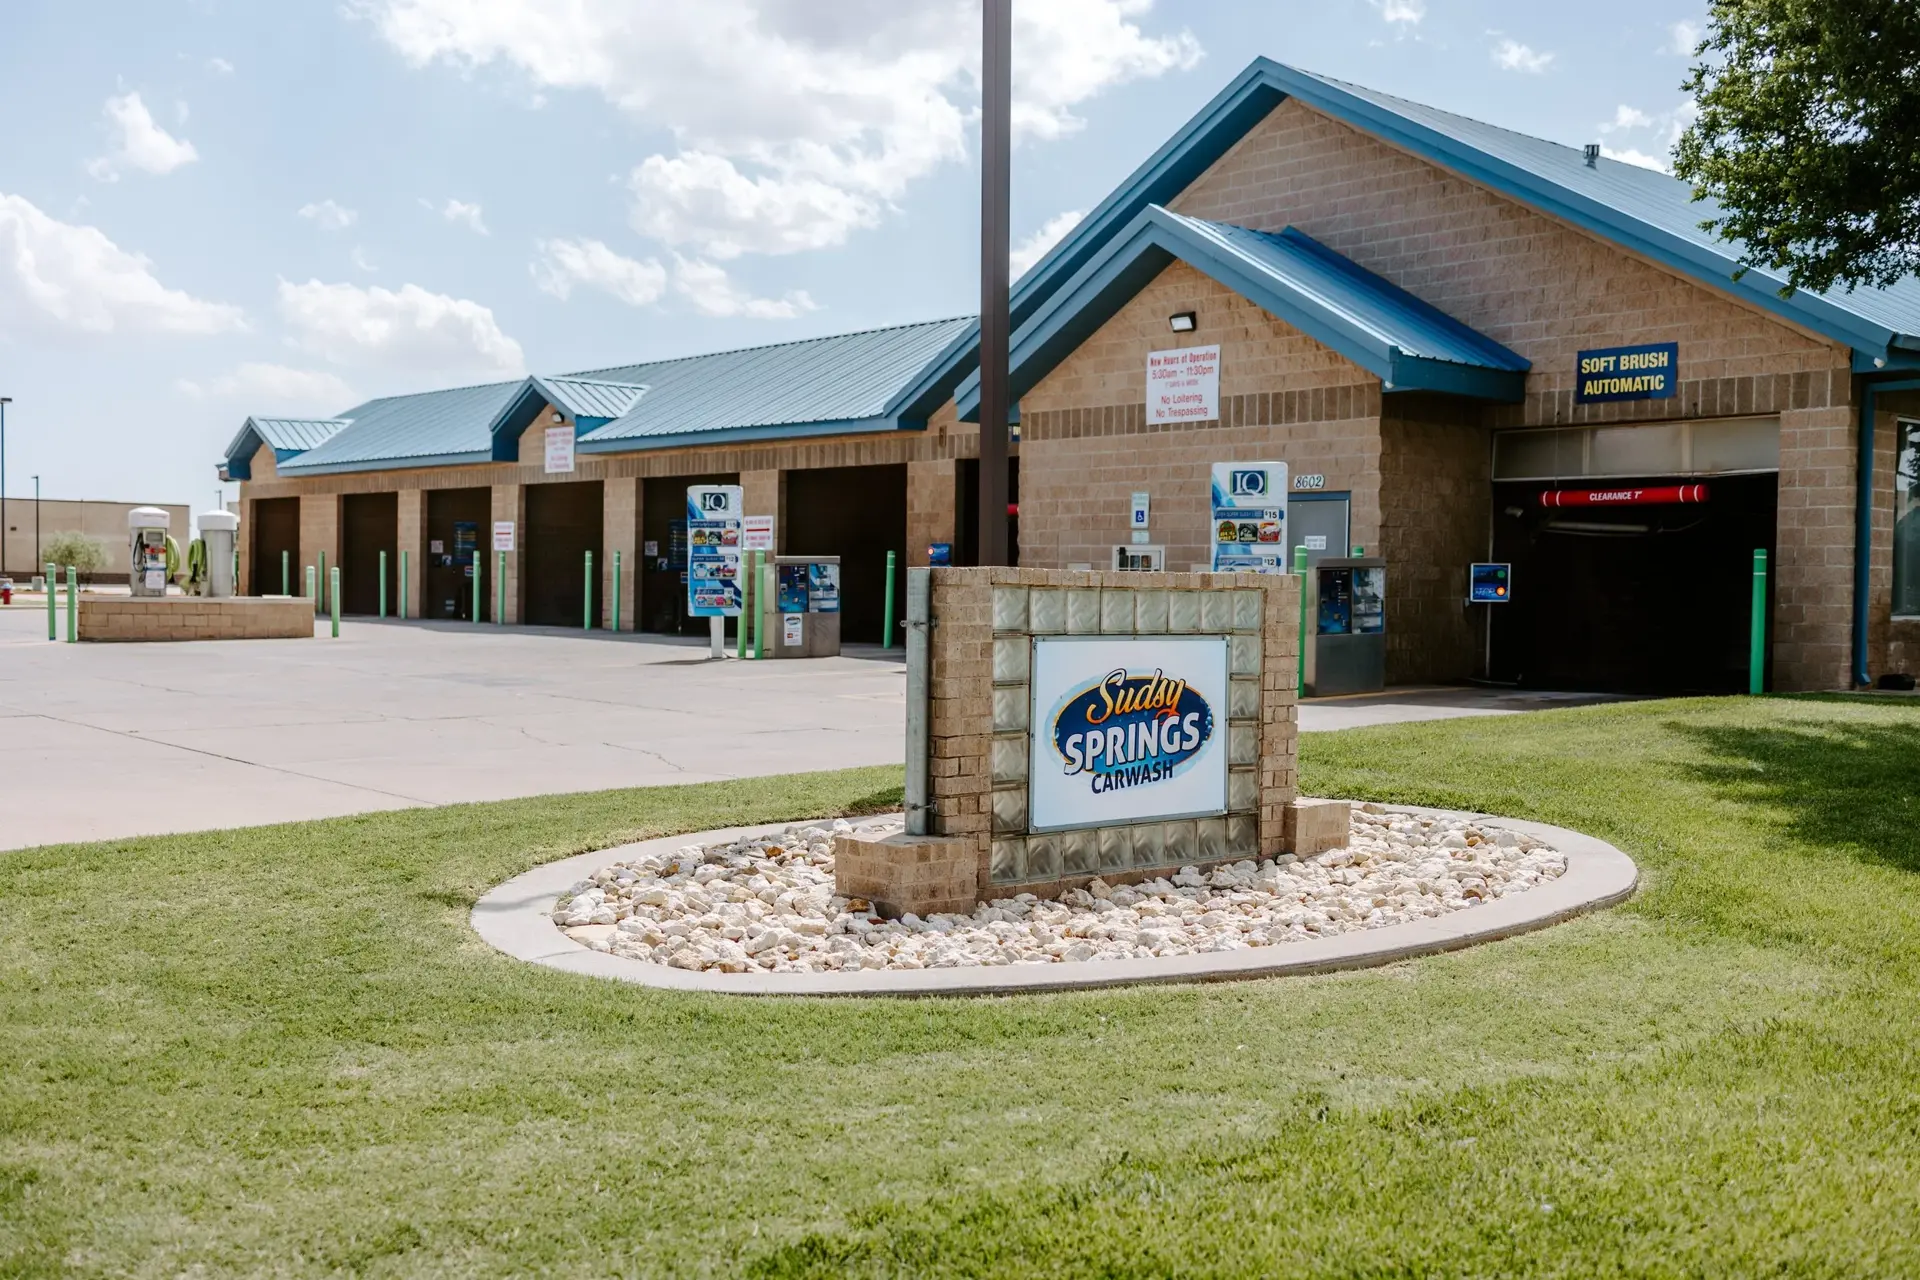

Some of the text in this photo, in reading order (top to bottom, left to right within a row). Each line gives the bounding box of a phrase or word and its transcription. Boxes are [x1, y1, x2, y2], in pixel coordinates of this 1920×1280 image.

[1150, 352, 1217, 367] New Hours of Operation
[1581, 351, 1669, 374] SOFT BRUSH
[1152, 369, 1177, 380] 5:30am
[1186, 364, 1214, 377] 11:30pm
[1583, 374, 1665, 396] AUTOMATIC
[1161, 393, 1203, 405] No Loitering
[1156, 405, 1208, 418] No Trespassing
[1233, 471, 1265, 497] IQ
[1295, 475, 1323, 489] 8602
[704, 493, 726, 511] IQ
[1589, 491, 1632, 501] CLEARANCE
[1264, 510, 1278, 519] $15
[1263, 558, 1275, 566] $12
[1086, 668, 1187, 725] Sudsy
[1063, 712, 1200, 776] SPRINGS
[1091, 759, 1174, 794] CARWASH
